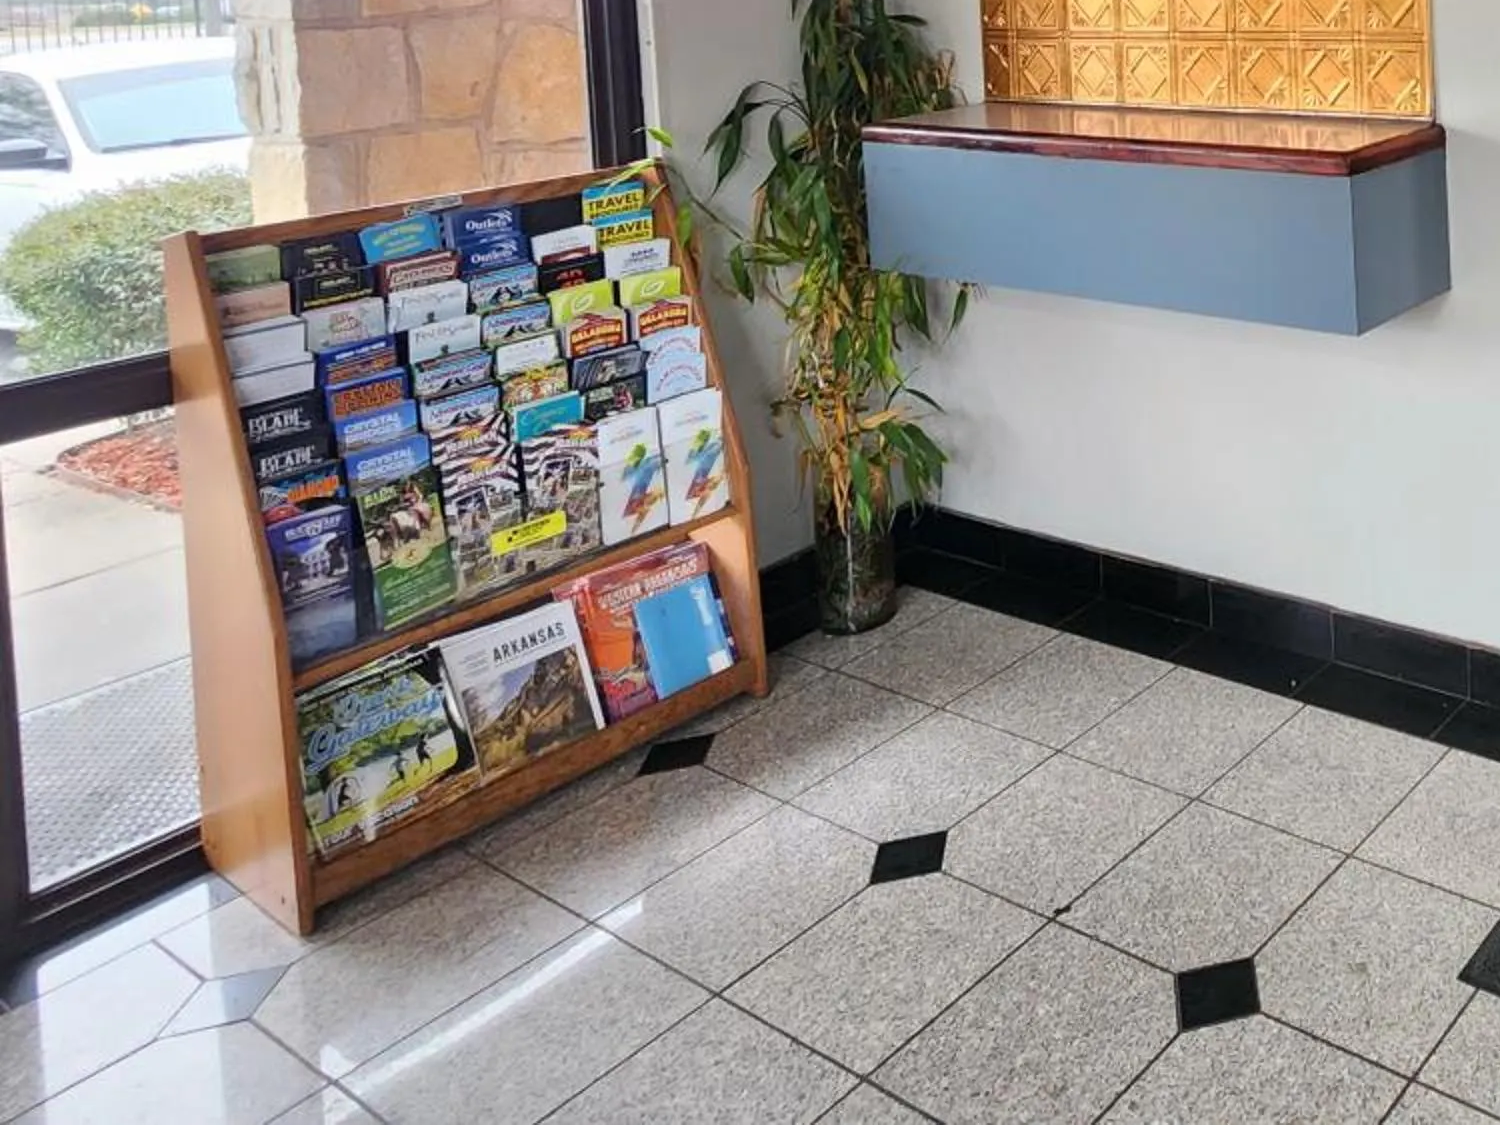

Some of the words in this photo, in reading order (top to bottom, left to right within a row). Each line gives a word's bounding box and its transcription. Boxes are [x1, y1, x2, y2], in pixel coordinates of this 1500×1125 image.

[588, 193, 641, 212] TRAVEL
[465, 217, 507, 233] Outlets
[600, 220, 652, 239] TRAVEL
[471, 247, 512, 264] Outlets
[493, 622, 566, 663] ARKANSAS
